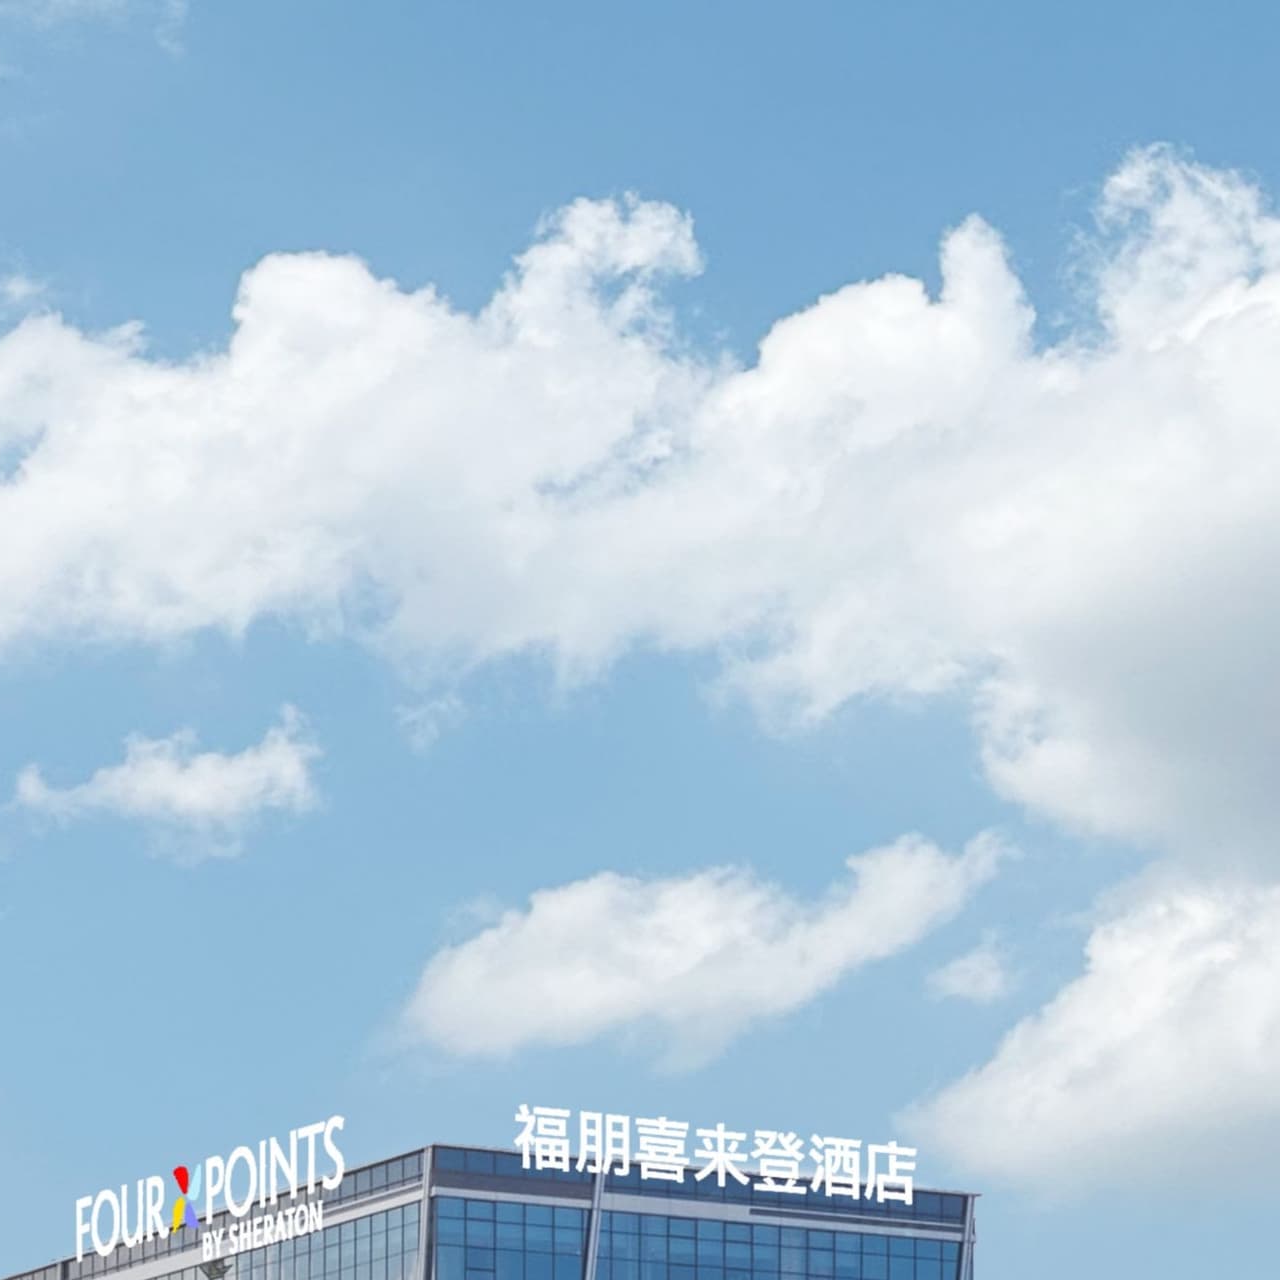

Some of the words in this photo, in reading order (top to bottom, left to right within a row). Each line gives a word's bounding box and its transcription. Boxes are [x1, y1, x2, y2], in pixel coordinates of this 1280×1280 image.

[76, 1175, 170, 1263] FOUR
[205, 1115, 346, 1225] POINTS
[514, 1104, 918, 1206] 福朋喜来登酒店
[202, 1227, 226, 1262] BY
[228, 1200, 324, 1255] SHERATON
